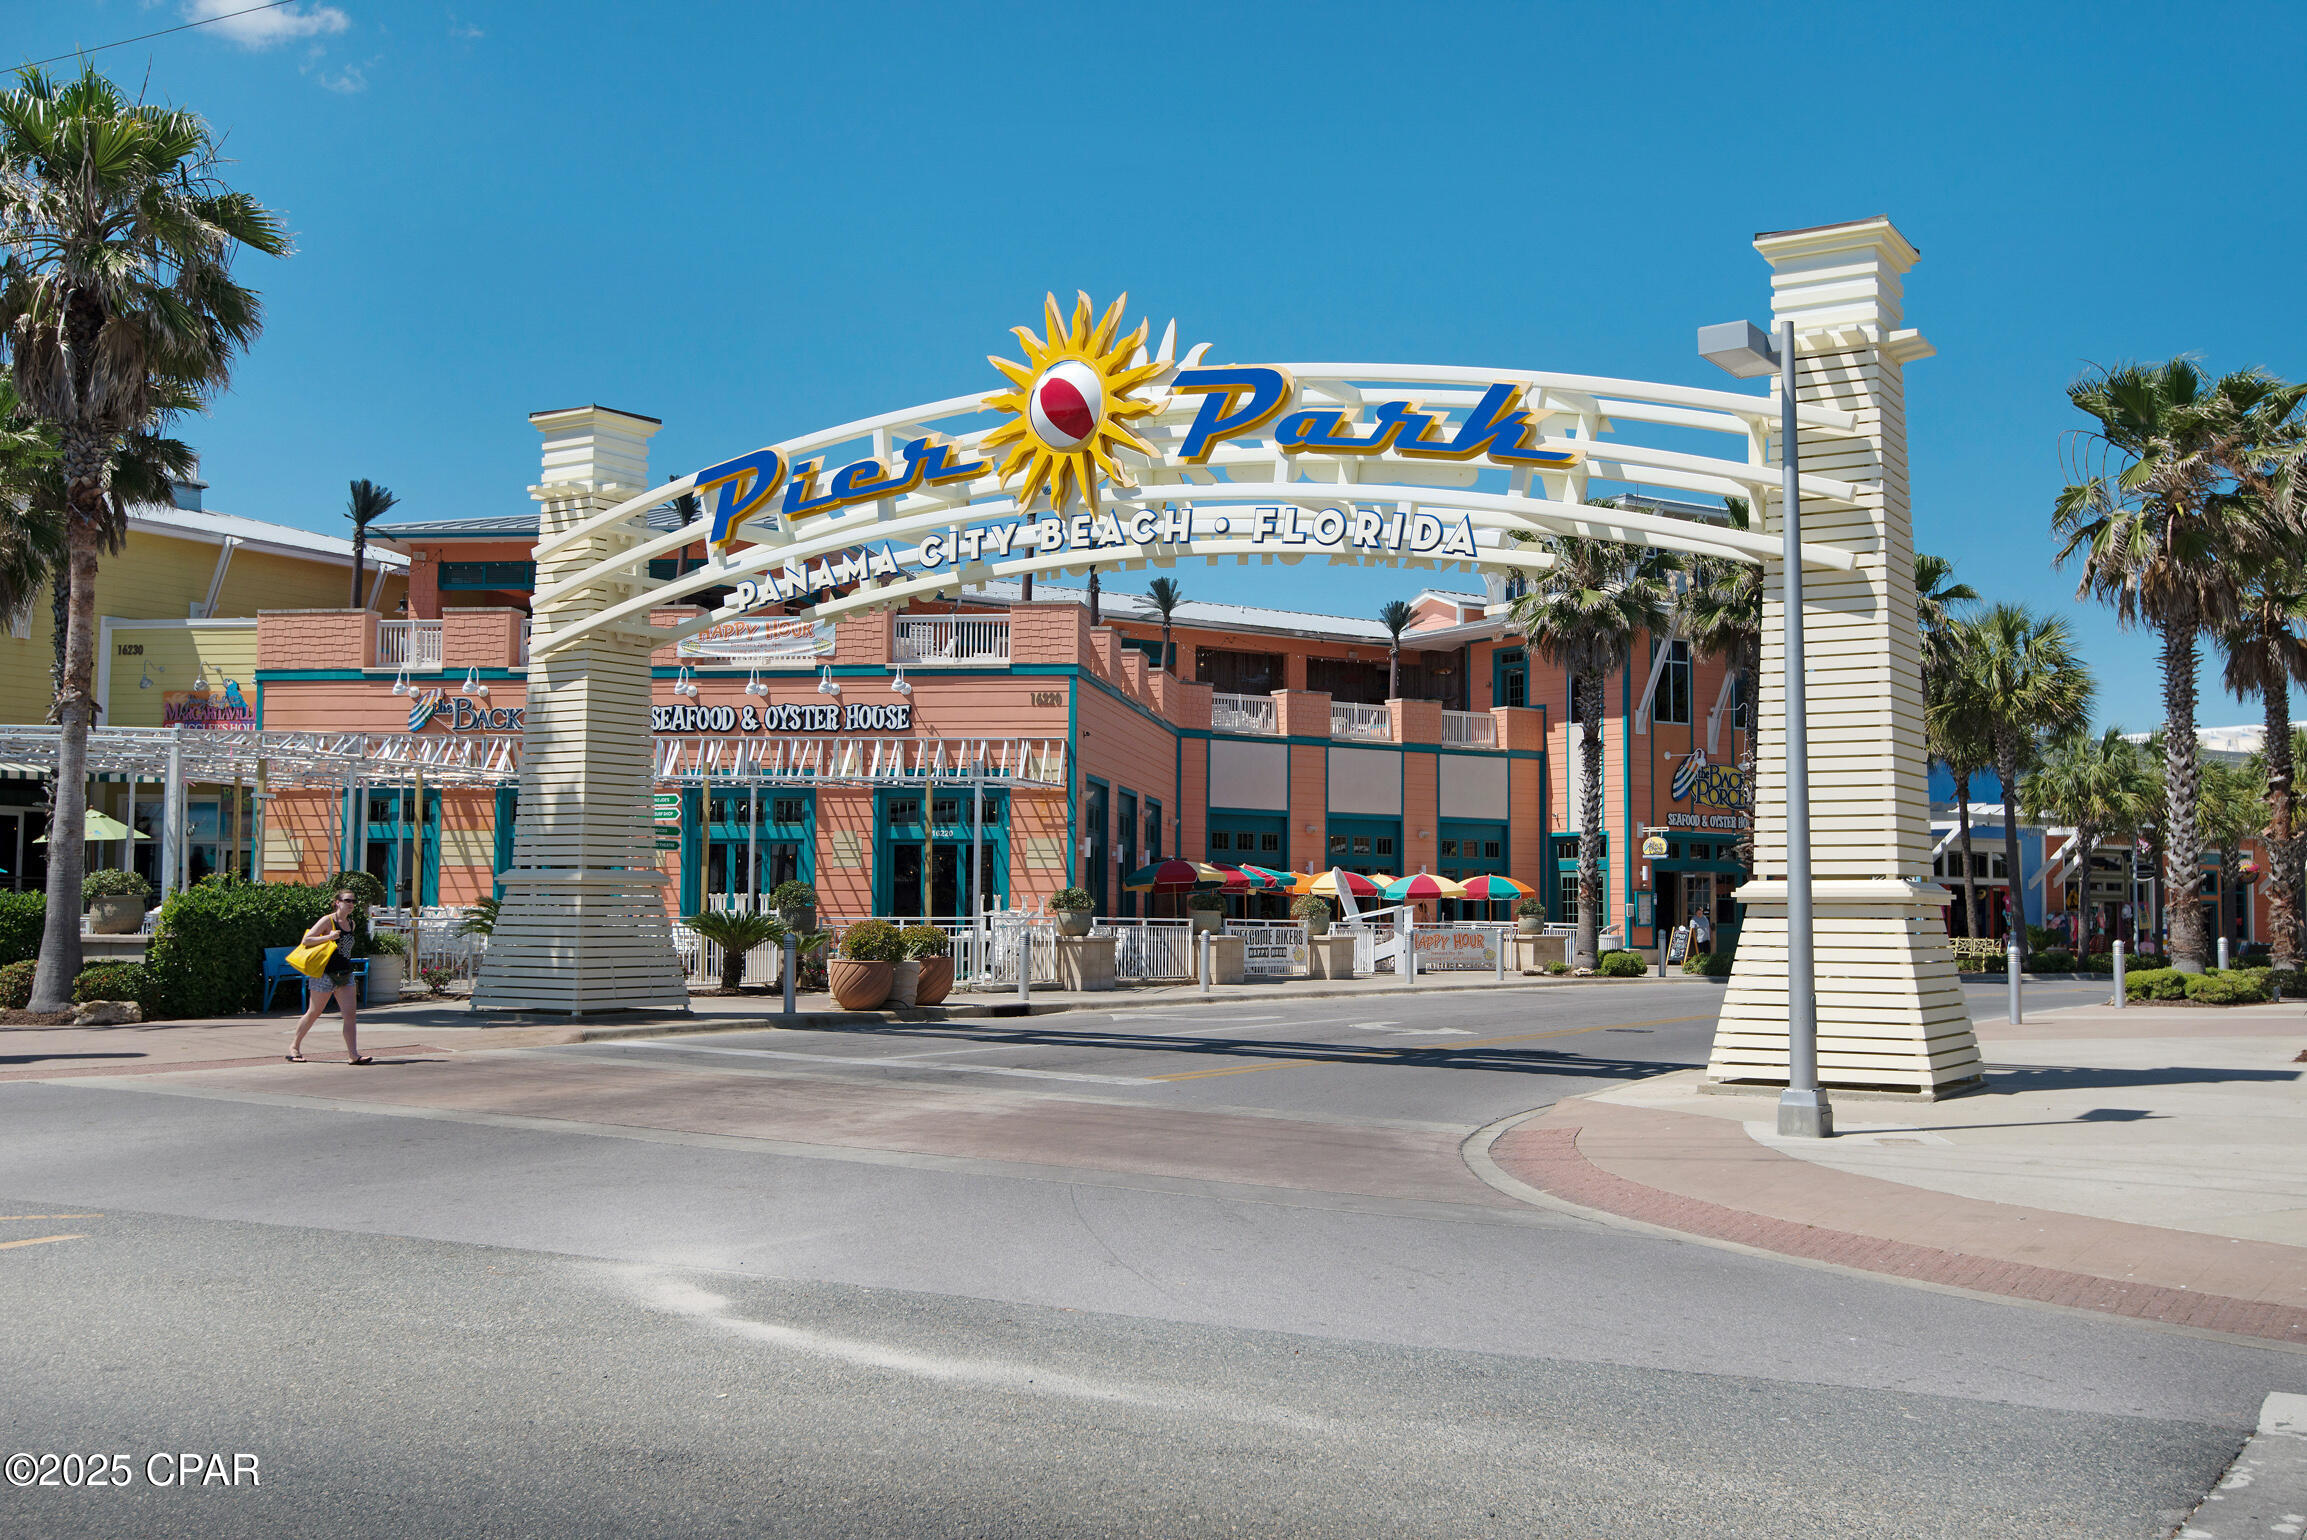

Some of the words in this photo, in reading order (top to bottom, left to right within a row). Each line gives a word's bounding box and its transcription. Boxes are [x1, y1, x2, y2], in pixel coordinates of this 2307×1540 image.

[692, 433, 995, 550] Pier
[1168, 365, 1586, 469] Park
[736, 541, 901, 612] PANAMA
[918, 522, 1019, 568] CITY
[1039, 508, 1194, 553] BEACH
[1251, 507, 1478, 557] FLORIDA
[764, 618, 815, 641] HOUR
[117, 644, 143, 655] 16230
[1030, 692, 1062, 707] 16220
[163, 702, 256, 721] MARGARITAVILL
[432, 699, 453, 714] the
[451, 697, 525, 731] BACK
[650, 704, 736, 732] SEAFOOD
[740, 704, 761, 732] &
[763, 703, 842, 732] OYSTER
[843, 704, 912, 731] HOUSE
[1667, 813, 1700, 827] SEAFOOD
[1701, 815, 1708, 827] &
[1709, 815, 1737, 828] OYSTER
[932, 829, 954, 837] 16220
[1275, 929, 1303, 945] BIKERS
[1453, 932, 1485, 949] HOUR
